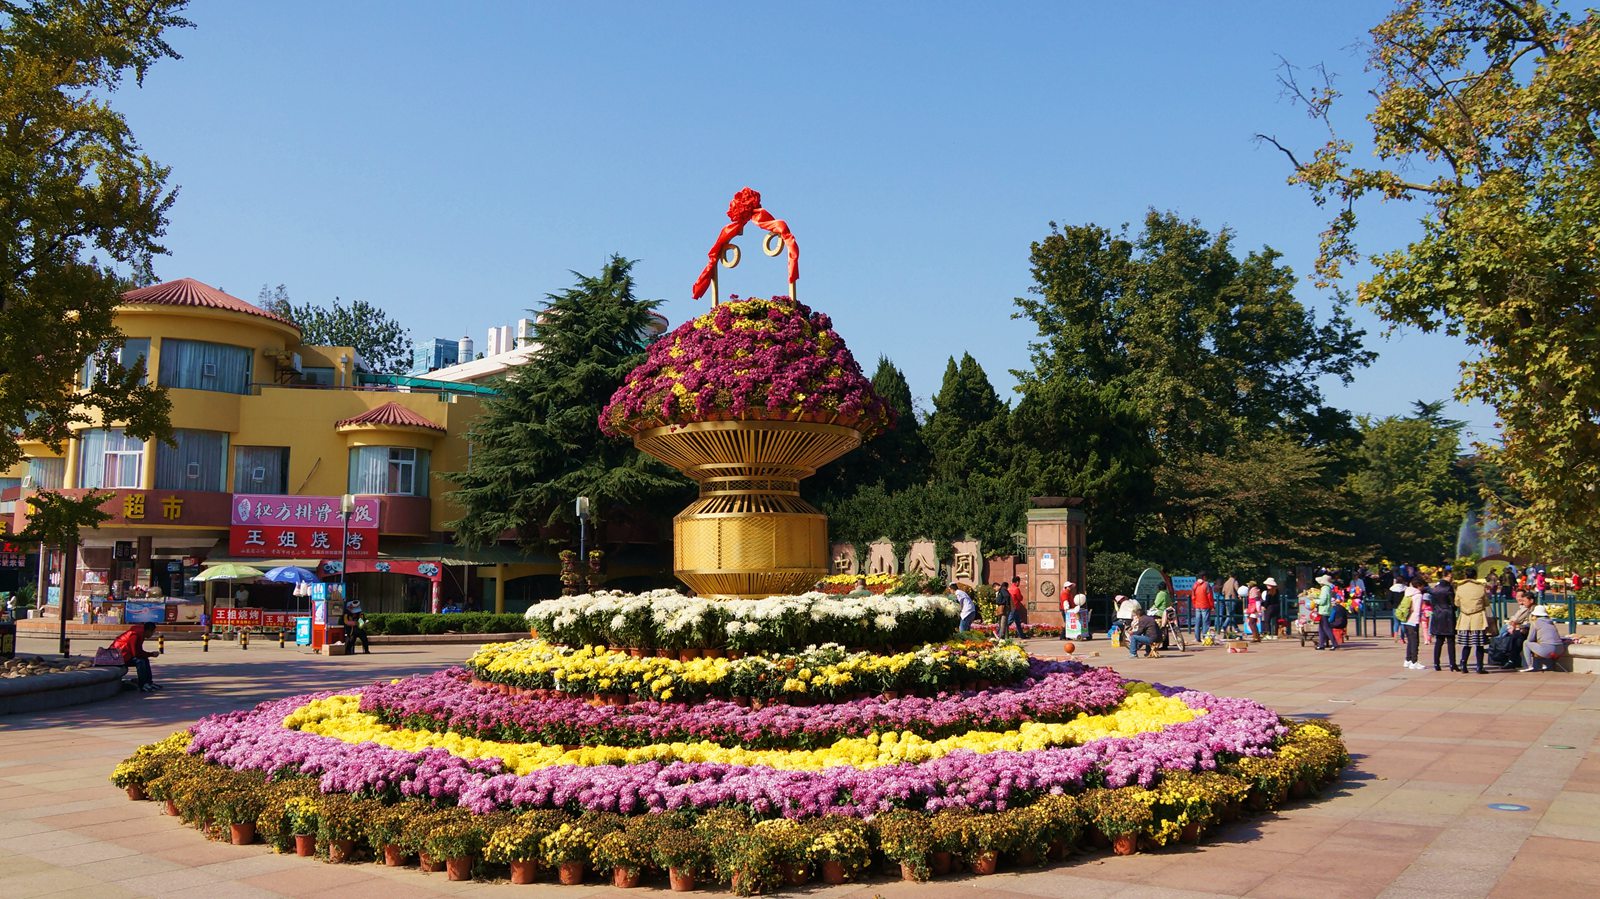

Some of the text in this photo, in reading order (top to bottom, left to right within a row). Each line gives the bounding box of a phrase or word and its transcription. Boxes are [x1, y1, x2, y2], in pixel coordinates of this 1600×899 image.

[123, 493, 184, 520] 超市
[244, 529, 363, 550] 王姐烧烤
[215, 609, 260, 620] 王姐烧烤
